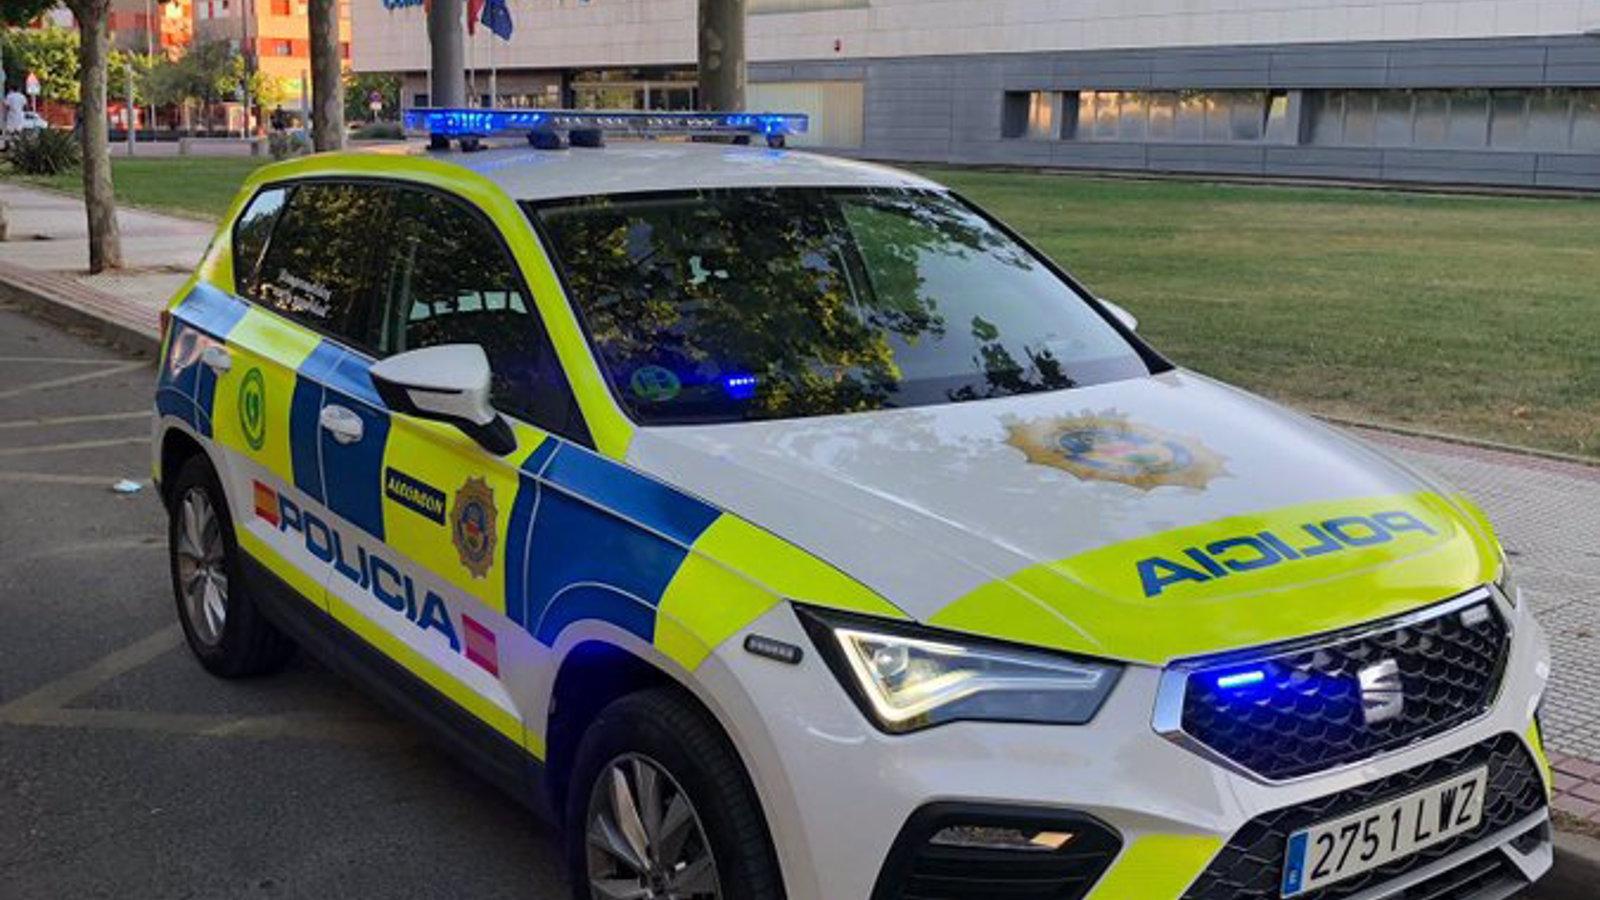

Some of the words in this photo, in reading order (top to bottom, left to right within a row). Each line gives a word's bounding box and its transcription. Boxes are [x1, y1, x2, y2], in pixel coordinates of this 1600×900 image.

[278, 492, 461, 654] POLICIA
[1310, 806, 1402, 881] 2751
[1414, 779, 1478, 843] LWZ
